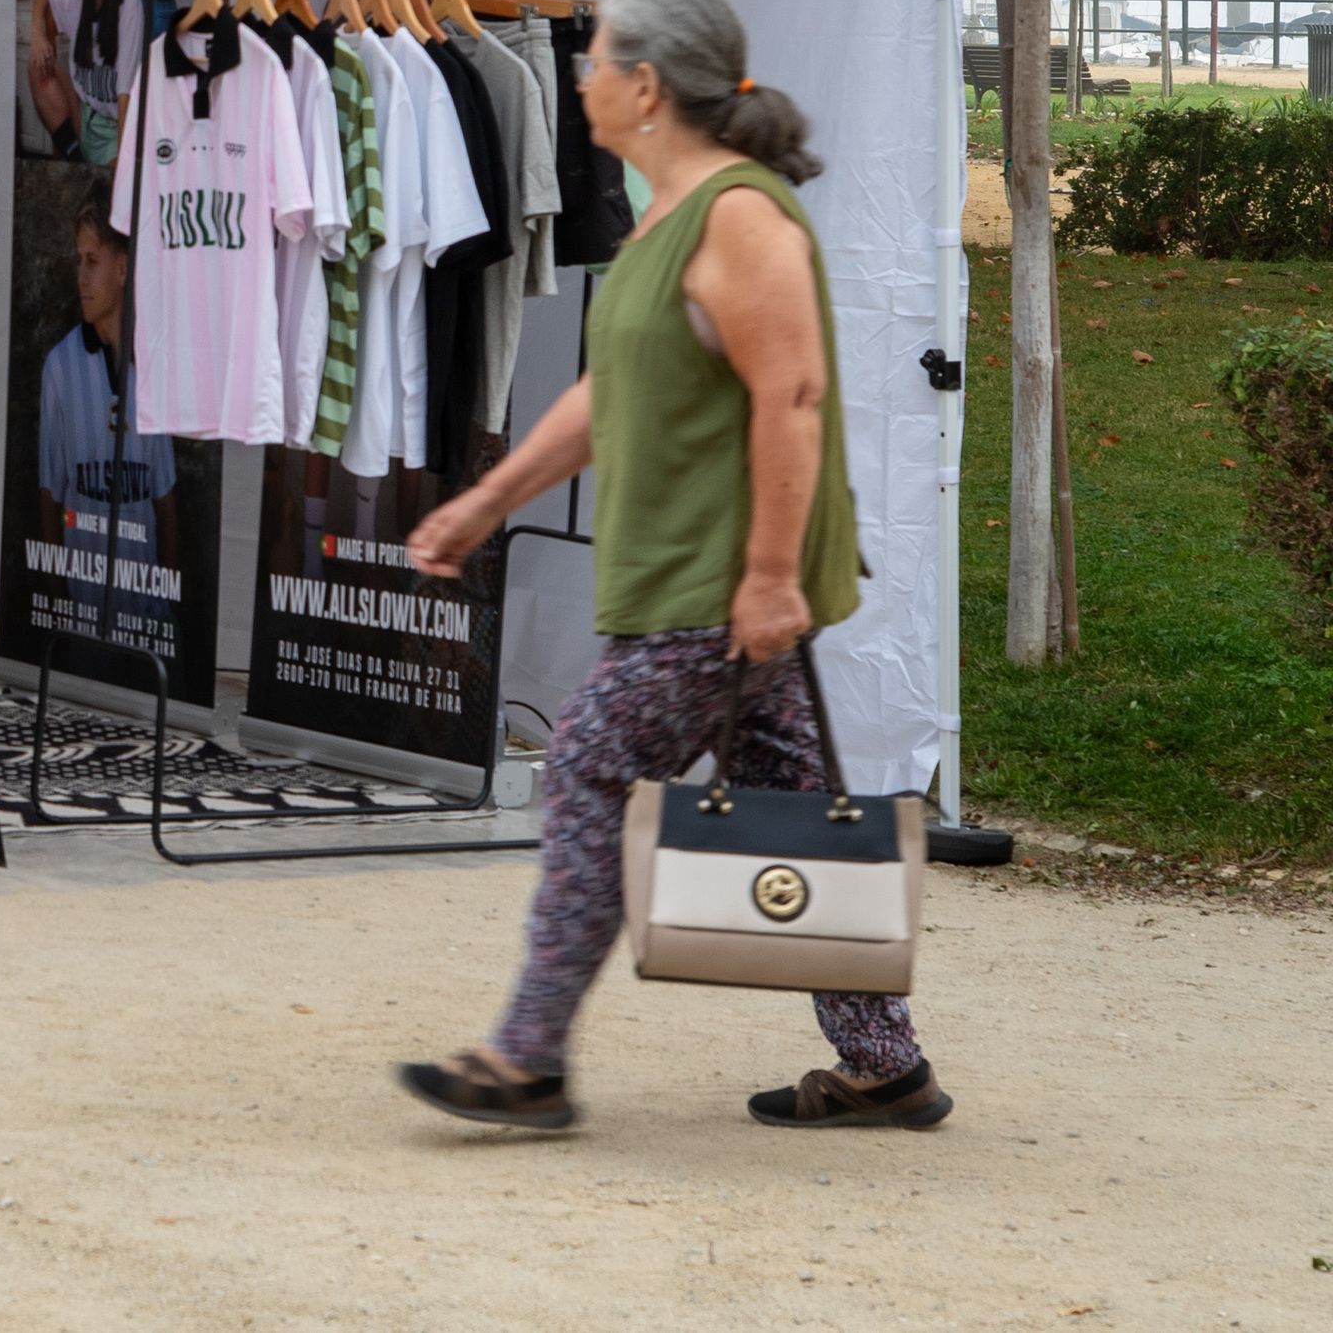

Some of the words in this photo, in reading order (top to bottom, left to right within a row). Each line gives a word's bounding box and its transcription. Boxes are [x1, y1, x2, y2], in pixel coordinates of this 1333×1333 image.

[76, 511, 98, 533] MADE
[99, 515, 108, 535] IN
[113, 518, 148, 543] RTUGAL
[336, 536, 364, 562] MADE
[365, 540, 377, 565] IN
[378, 542, 417, 570] PORTU
[117, 611, 143, 631] SILVA
[270, 573, 470, 644] WWW.ALLSLOWLY.COM
[153, 638, 176, 659] XIRA
[278, 639, 299, 661] RUA
[336, 650, 363, 673] DIAS
[367, 655, 382, 676] DA
[388, 659, 421, 683] SILVA
[426, 666, 442, 686] 27
[446, 670, 460, 691] 31
[276, 661, 331, 689] 2600-170
[335, 673, 361, 695] VILA
[365, 678, 410, 705] FRANCA
[415, 687, 430, 709] DE
[435, 692, 462, 715] XIRA
